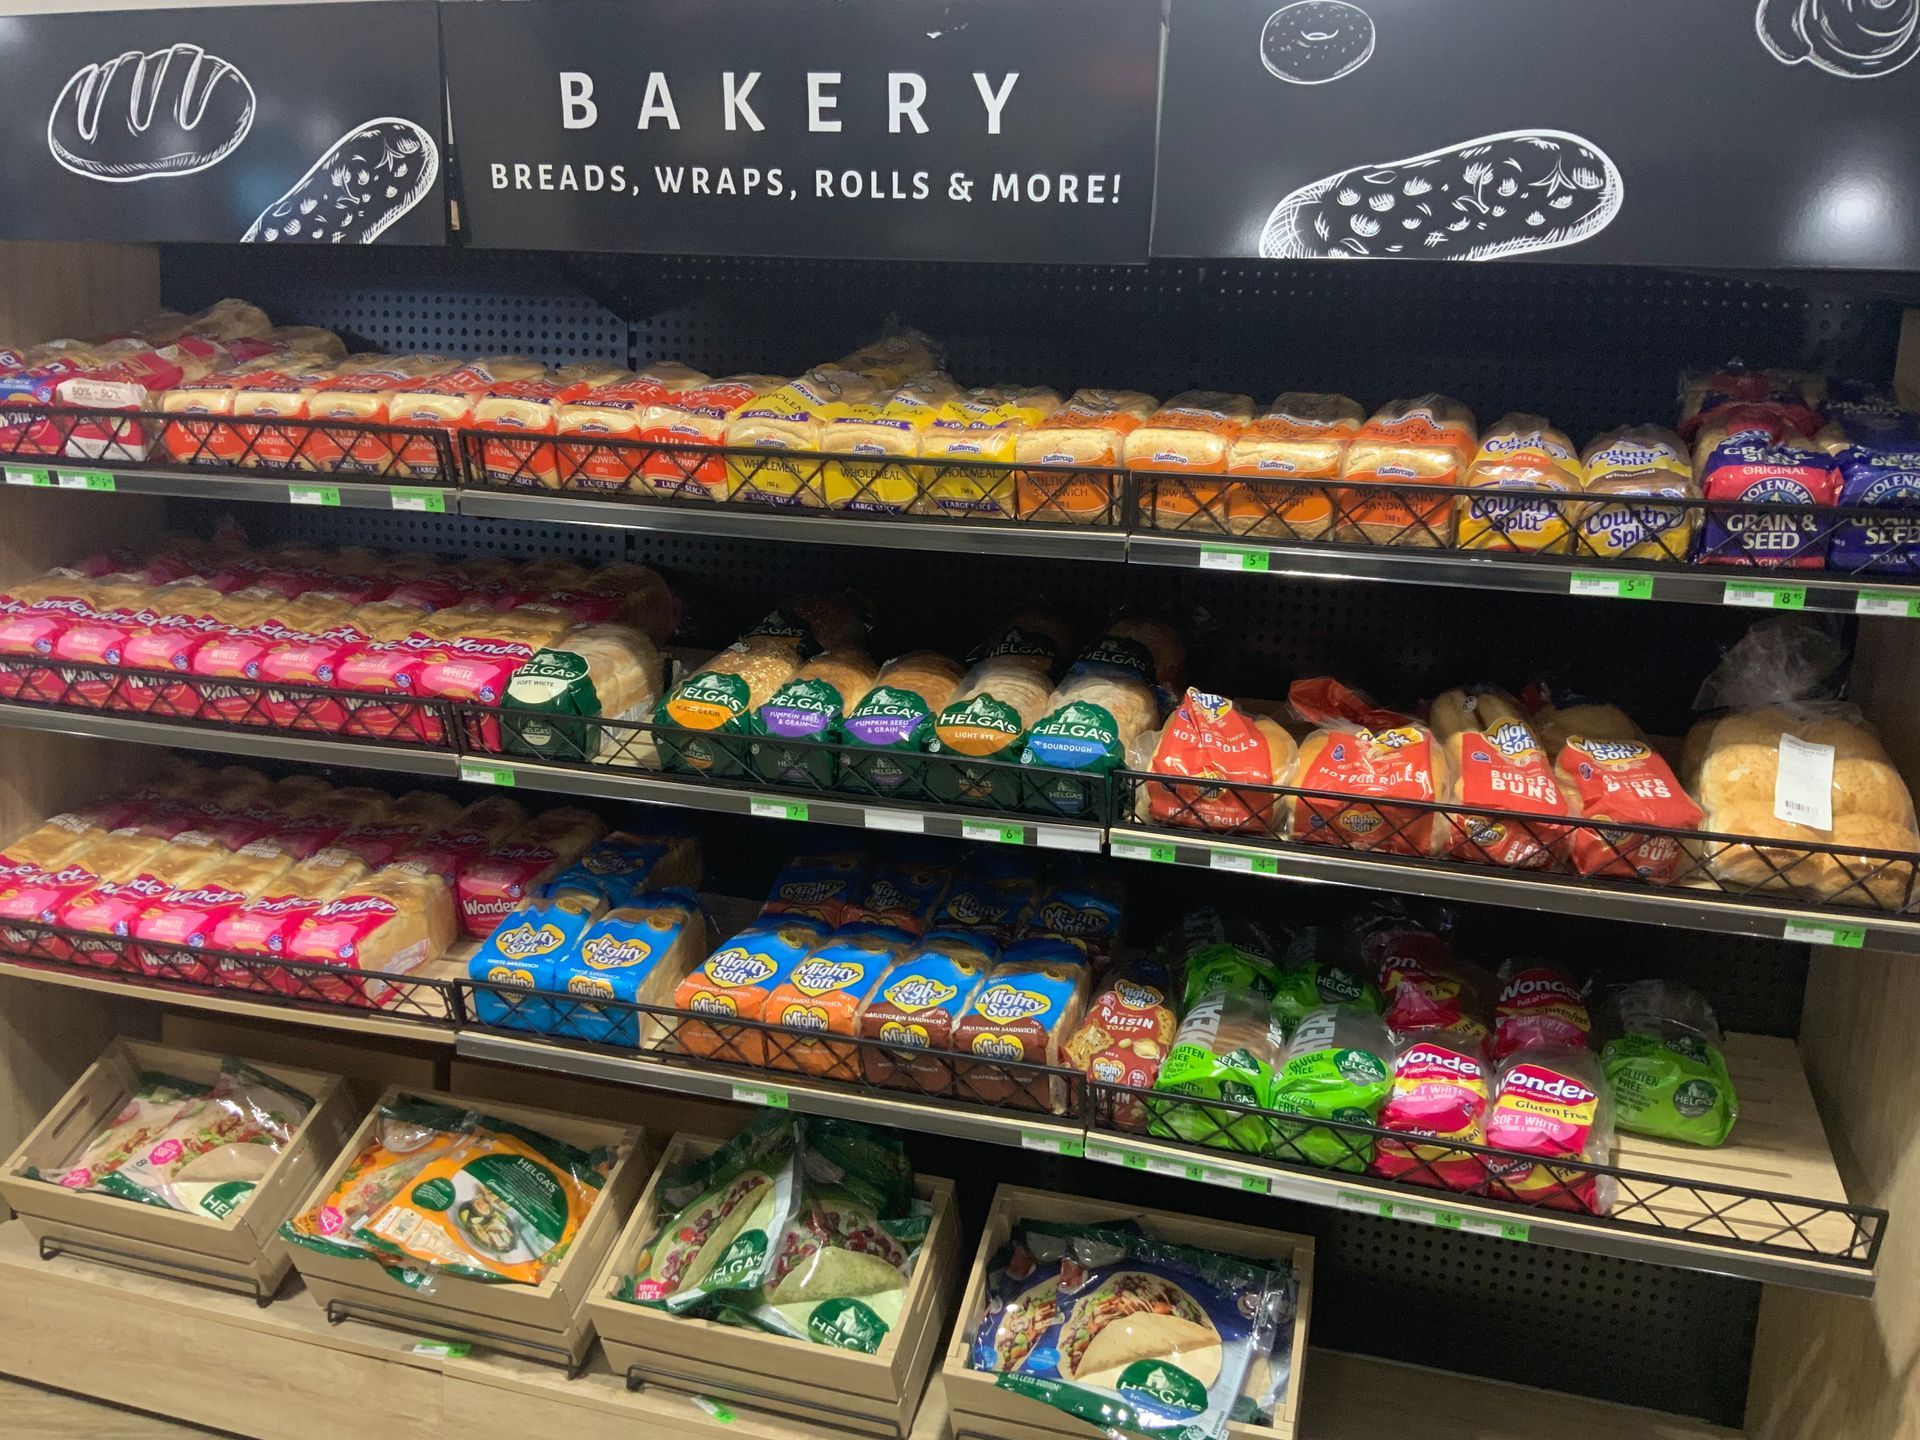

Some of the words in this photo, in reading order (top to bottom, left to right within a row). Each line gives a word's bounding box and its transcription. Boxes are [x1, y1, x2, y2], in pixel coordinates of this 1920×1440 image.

[559, 72, 1019, 134] BAKERY
[491, 163, 639, 196] BREADS,
[655, 166, 798, 200] WRAPS,
[815, 170, 929, 200] ROLLS
[948, 173, 973, 202] &
[992, 174, 1122, 203] MORE!
[855, 445, 884, 454] Buttercup
[1042, 454, 1074, 464] Buttercup
[1154, 453, 1187, 464] Buttercup
[1259, 461, 1294, 472] Buttercup
[1378, 467, 1415, 478] Buttercup
[1742, 466, 1809, 476] ORIGINAL
[1491, 513, 1543, 534] Split
[1726, 514, 1797, 532] GRAIN
[1801, 514, 1818, 532] &
[1743, 531, 1800, 550] SEED
[211, 650, 241, 660] WHITE
[442, 666, 475, 681] WHITE
[851, 706, 924, 719] HELGA'S
[939, 713, 1018, 734] HELGA'S
[954, 731, 979, 740] LIGHT
[1033, 726, 1116, 745] HELGA'S
[1173, 728, 1198, 744] HOT
[1042, 742, 1093, 753] SOURDOUGH
[1319, 766, 1346, 782] HOT
[1379, 768, 1425, 785] ROLLS
[1491, 778, 1558, 805] BUNS
[463, 899, 518, 916] Wonder
[712, 950, 772, 978] Mighty
[798, 961, 859, 981] Mighty
[712, 965, 749, 985] Soft
[800, 974, 835, 989] Soft
[571, 981, 613, 998] Mighty
[1119, 984, 1158, 1004] Mighty
[1316, 975, 1362, 998] HELGA'S
[693, 999, 736, 1017] Mighty
[980, 988, 1048, 1012] Mighty
[1122, 995, 1146, 1008] Soft
[987, 1003, 1024, 1018] Soft
[1101, 1006, 1155, 1029] RAISIN
[785, 1012, 827, 1032] Mighty
[907, 1015, 943, 1025] SANDWICH
[883, 1027, 928, 1048] Mighty
[1001, 1025, 1038, 1034] SANDWICH
[975, 1041, 1020, 1058] Mighty
[1095, 1062, 1122, 1075] Mighty
[1288, 1052, 1325, 1072] GLUTEN
[1099, 1071, 1115, 1082] Soft
[1620, 1065, 1660, 1087] GLUTEN
[1429, 1086, 1466, 1098] WHITE
[1617, 1077, 1643, 1093] FREE
[1278, 1101, 1301, 1114] FREE
[1515, 1099, 1560, 1116] Gluten
[1562, 1109, 1589, 1121] Free
[1492, 1114, 1523, 1126] SOFT
[1524, 1115, 1561, 1134] WHITE
[517, 1158, 558, 1193] HELGA'S
[1019, 1375, 1035, 1384] LESS
[1034, 1378, 1063, 1392] SODIUM!
